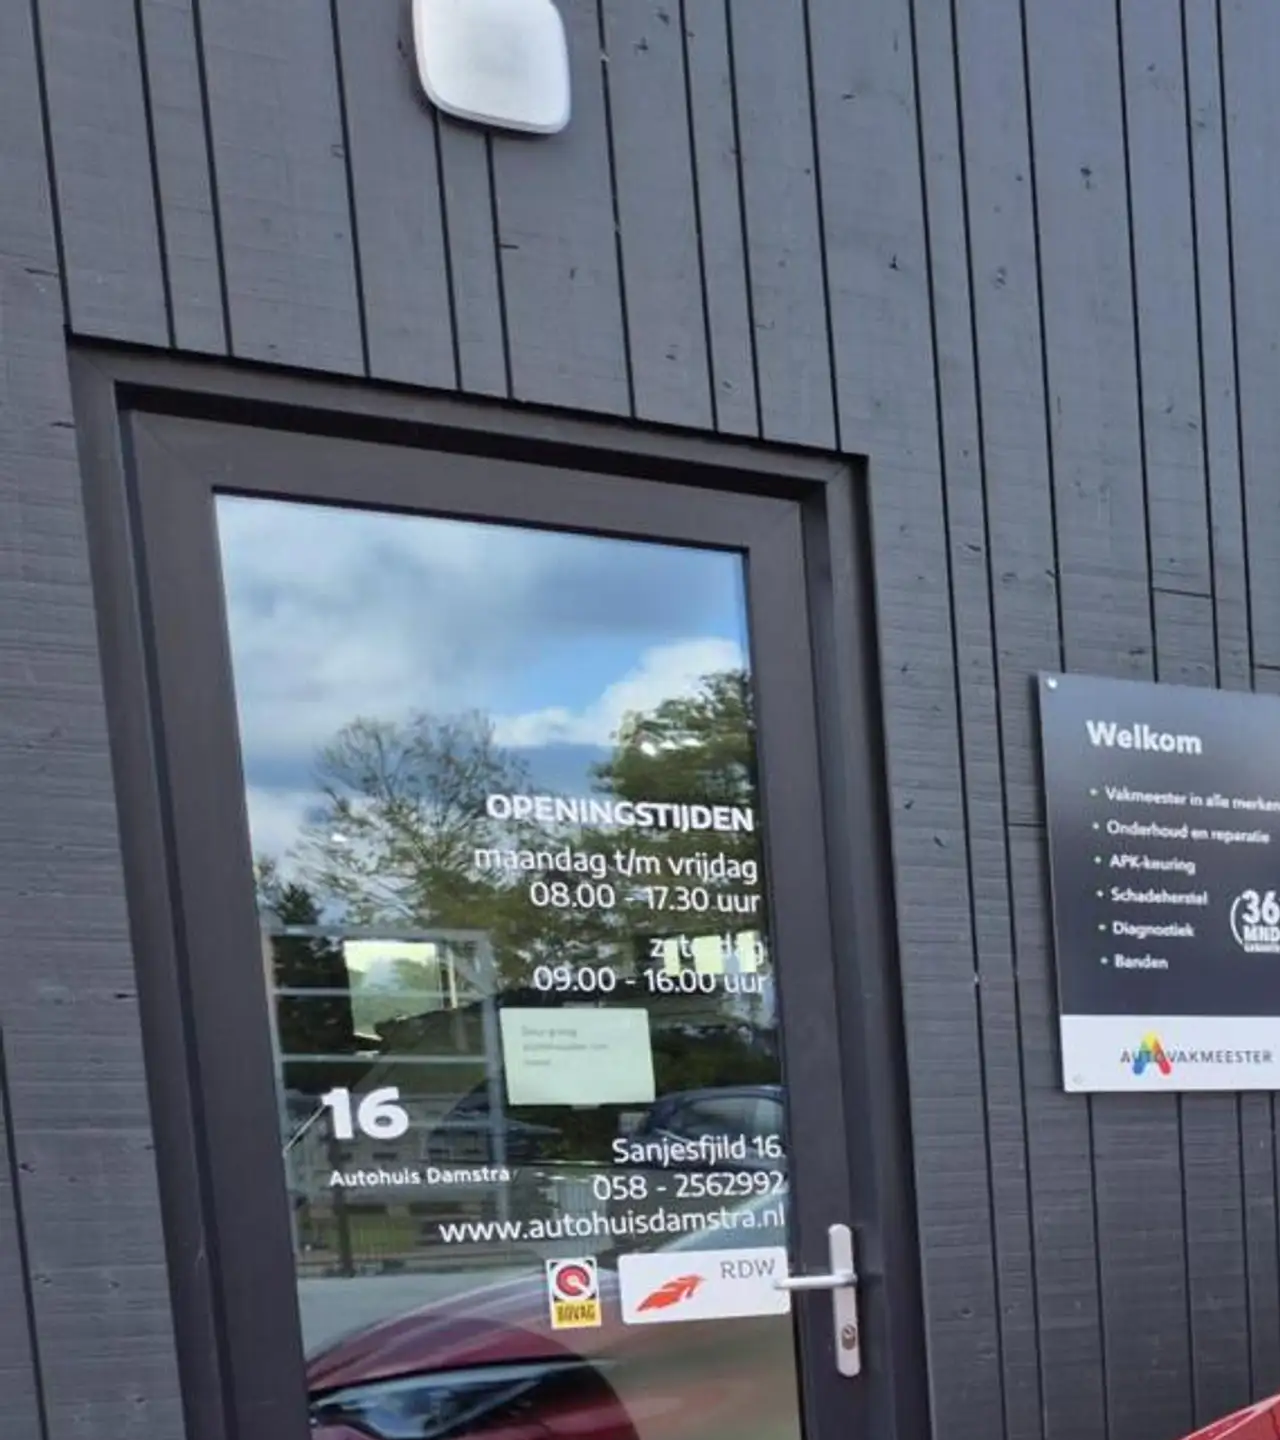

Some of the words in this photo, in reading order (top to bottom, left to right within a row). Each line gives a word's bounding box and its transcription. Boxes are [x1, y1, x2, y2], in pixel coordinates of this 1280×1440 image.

[1086, 719, 1203, 755] Welkom
[1105, 785, 1187, 805] Vakmeester
[1189, 793, 1203, 806] in
[1206, 793, 1229, 808] alle
[486, 794, 754, 832] OPENINGSTIJDEN
[1106, 819, 1189, 839] Onderhoud
[1191, 827, 1209, 839] en
[1211, 829, 1270, 844] reparatie
[474, 846, 606, 879] maandag
[614, 848, 661, 877] t/m
[668, 851, 757, 884] vrijdag
[1109, 854, 1196, 876] APK-keuring
[529, 882, 615, 908] 08.00
[644, 886, 709, 912] 17.30
[717, 896, 760, 913] uur
[1110, 887, 1208, 905] Schadeherstel
[1241, 889, 1280, 925] 36
[1112, 921, 1195, 939] Diagnostiek
[1114, 953, 1169, 969] Banden
[533, 966, 616, 993] 09.00
[644, 970, 717, 994] 16.00
[724, 972, 766, 994] uur
[321, 1085, 409, 1141] 16
[611, 1135, 746, 1166] Sanjesfjild
[756, 1136, 781, 1159] 16
[329, 1168, 421, 1188] Autohuis
[427, 1166, 511, 1186] Damstra
[593, 1176, 647, 1201] 058
[675, 1171, 784, 1198] 2562992
[438, 1205, 785, 1244] www.autohuisdamstra.nl
[721, 1258, 776, 1280] RDW
